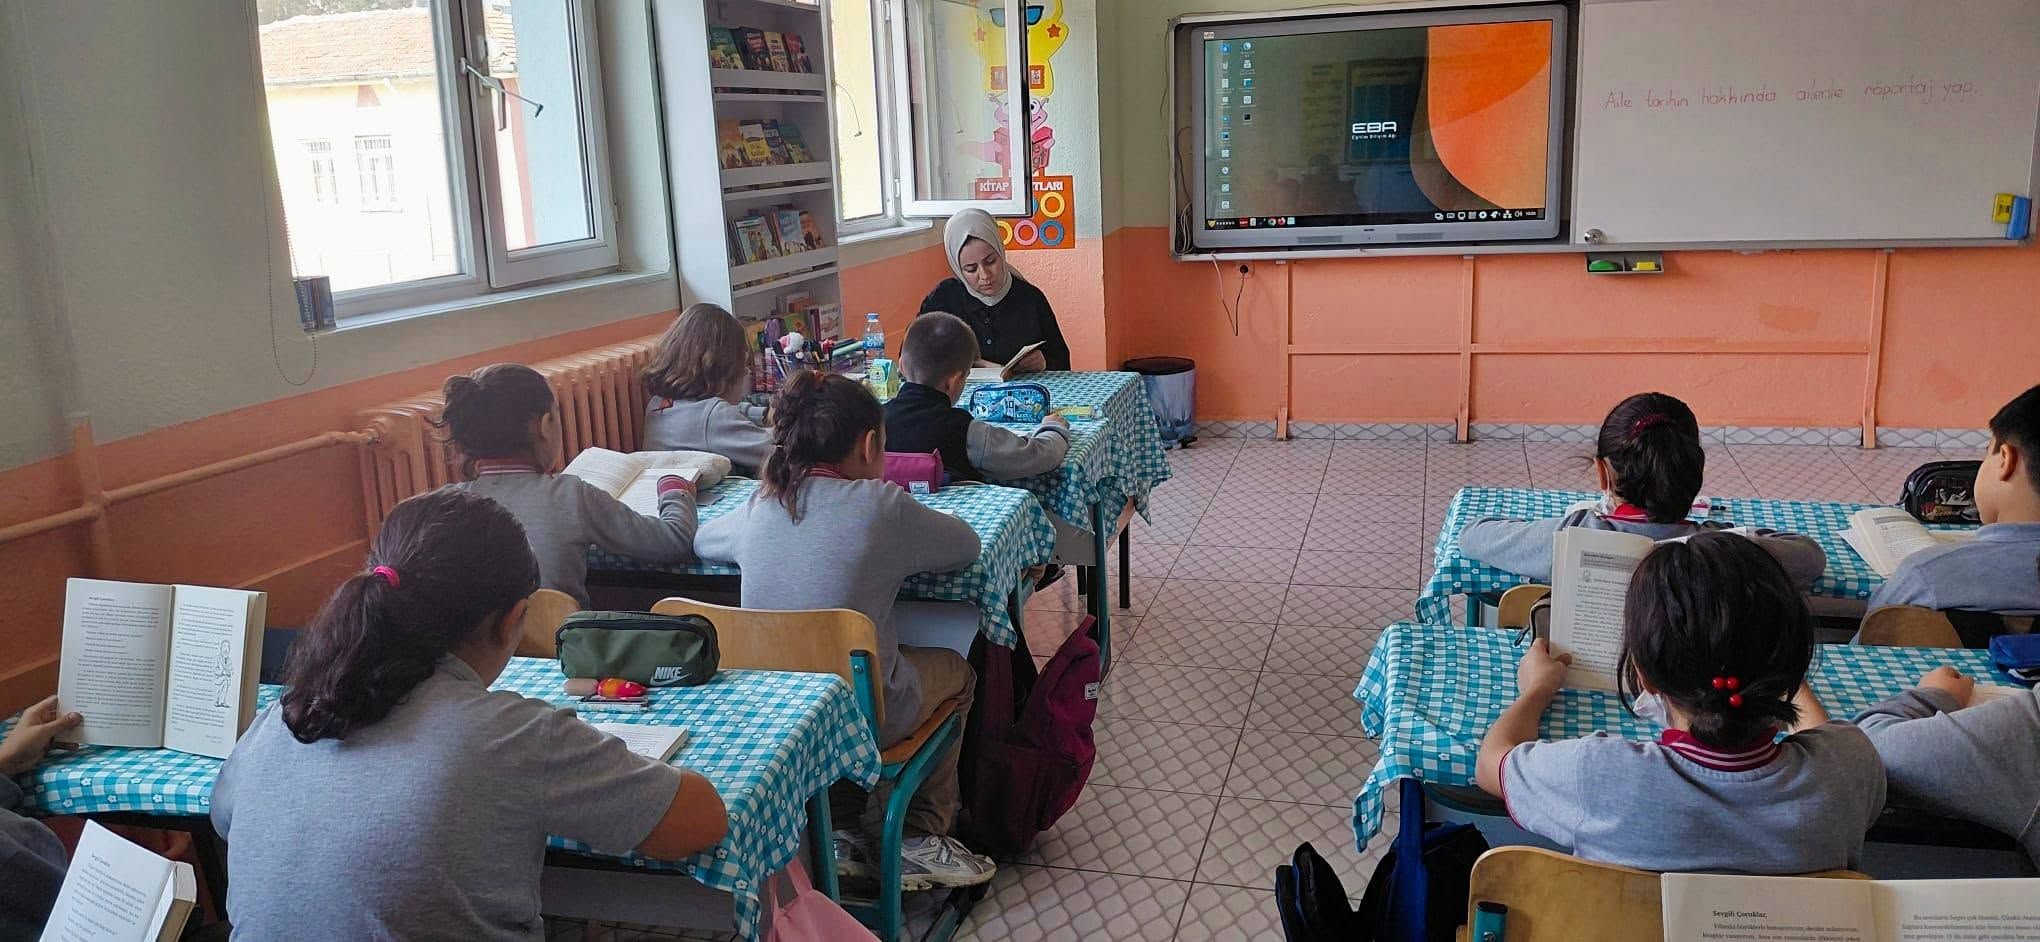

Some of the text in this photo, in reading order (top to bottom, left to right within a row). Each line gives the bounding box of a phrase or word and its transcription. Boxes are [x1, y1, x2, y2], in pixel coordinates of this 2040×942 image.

[1604, 91, 1632, 108] Aile
[1352, 121, 1397, 133] EBA
[979, 180, 1064, 192] KİTAP TLARI
[654, 666, 683, 680] NIKE
[1712, 910, 1735, 918] Sevgili
